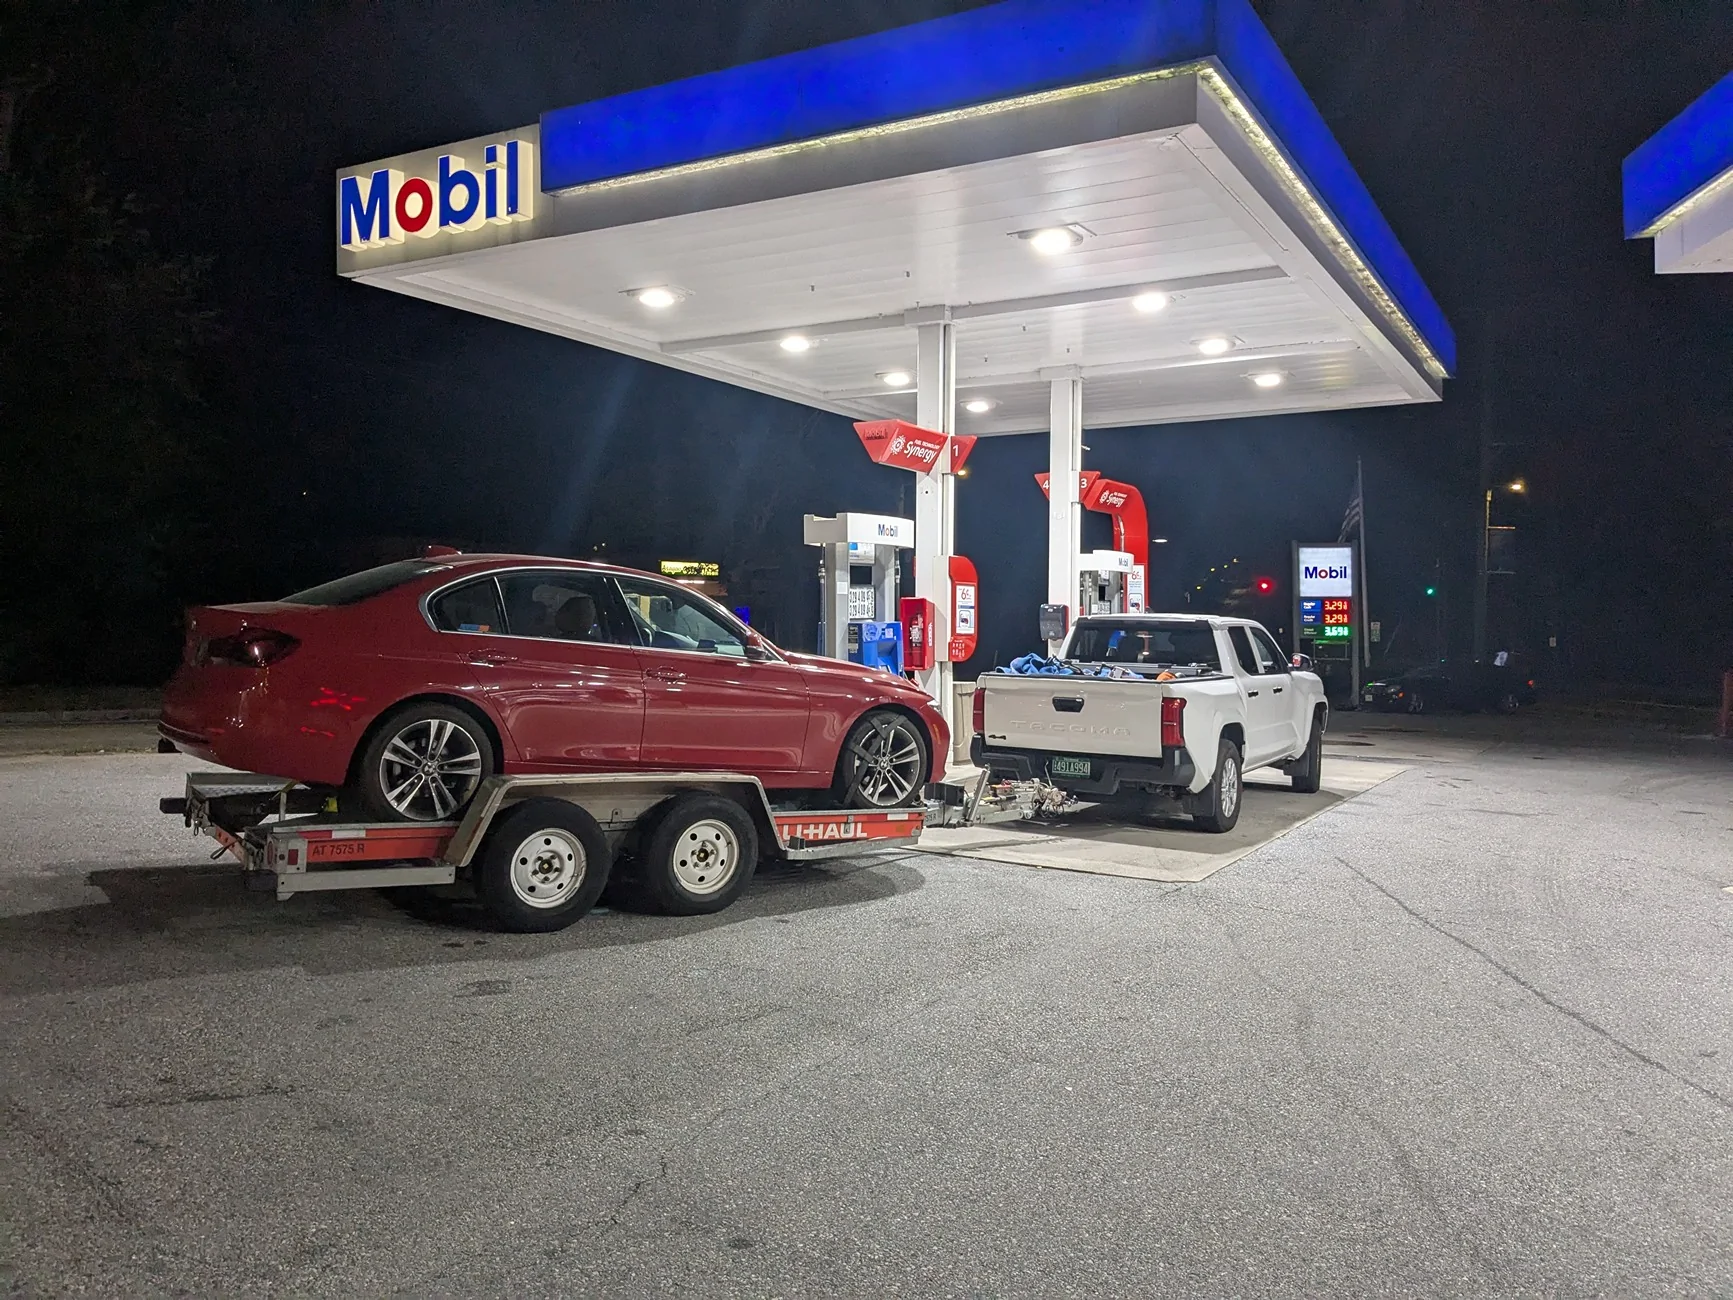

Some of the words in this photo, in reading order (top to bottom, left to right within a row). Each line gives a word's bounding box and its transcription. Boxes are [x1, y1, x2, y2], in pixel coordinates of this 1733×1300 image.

[340, 140, 521, 247] Mobil
[904, 442, 937, 463] Synergy
[953, 445, 959, 457] 1
[1043, 480, 1050, 489] 4
[1080, 478, 1088, 488] 3
[878, 523, 899, 538] Mobil
[1304, 566, 1347, 579] Mobil
[1010, 720, 1131, 736] TACOMA
[782, 822, 868, 840] U-HAUL
[312, 844, 326, 856] AT
[330, 843, 354, 856] 7575
[357, 843, 365, 854] R
